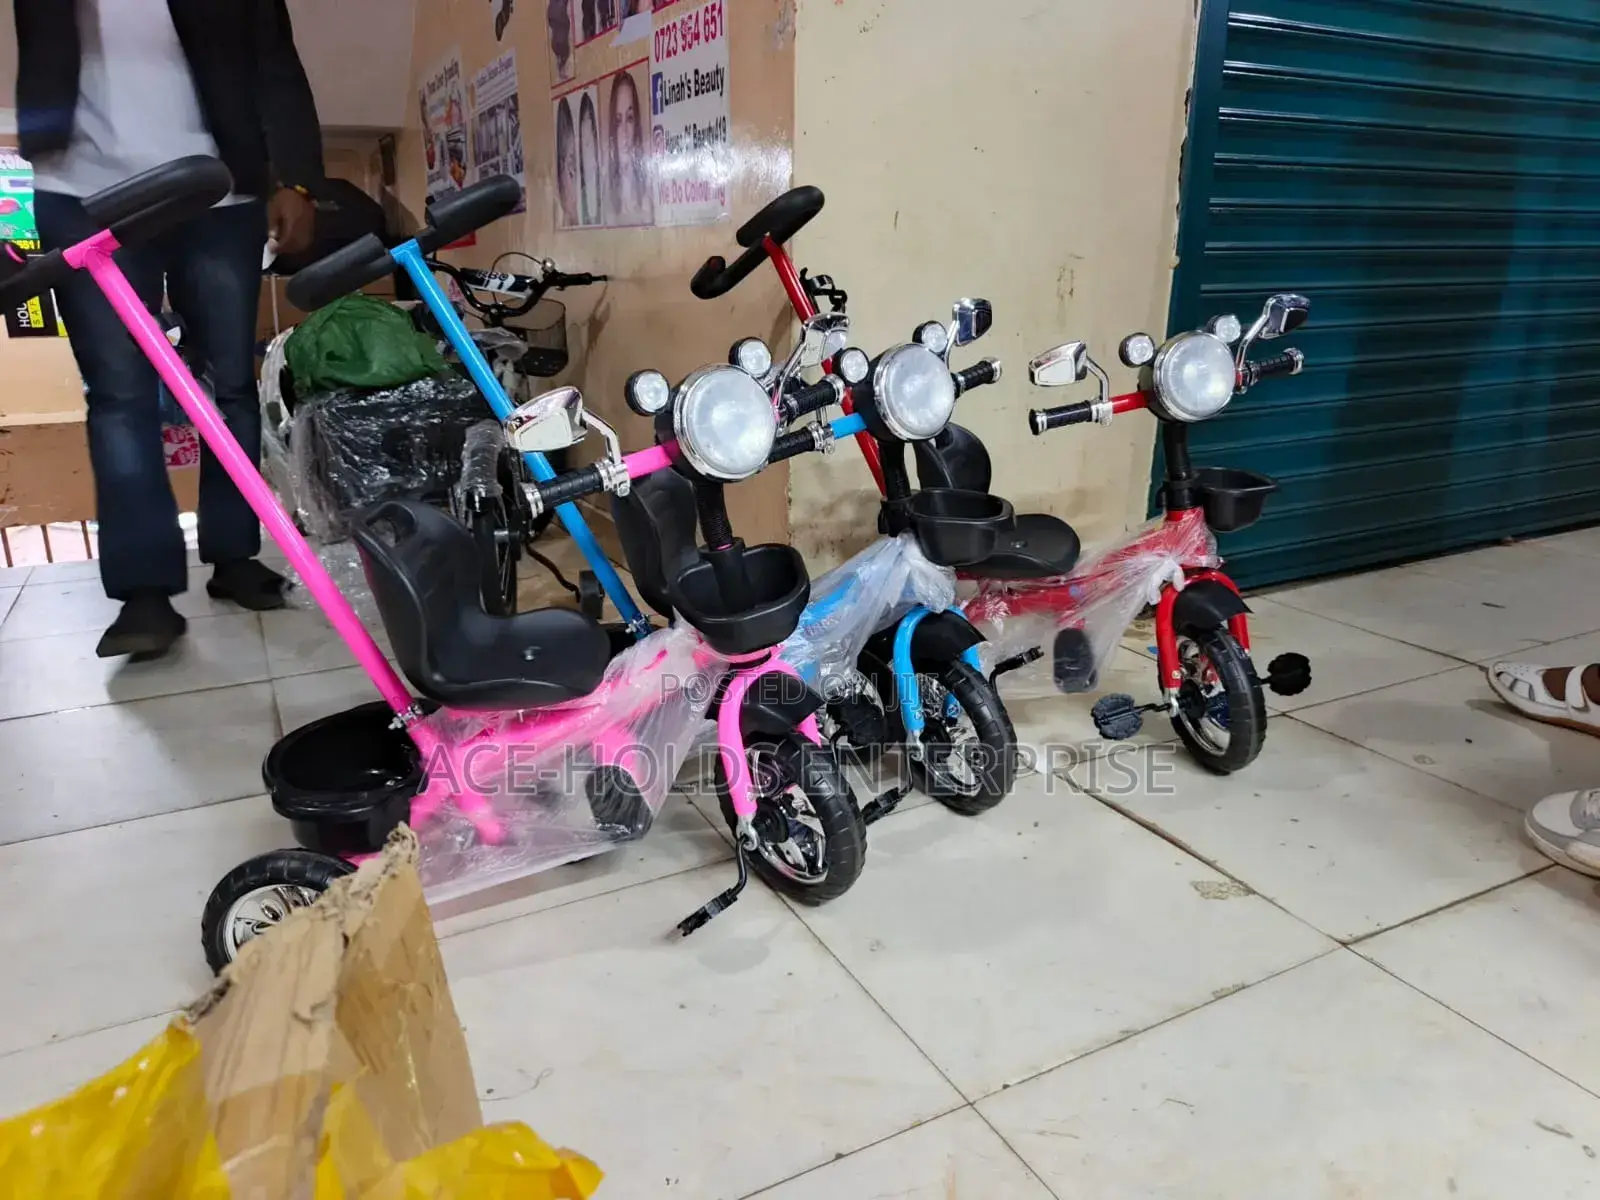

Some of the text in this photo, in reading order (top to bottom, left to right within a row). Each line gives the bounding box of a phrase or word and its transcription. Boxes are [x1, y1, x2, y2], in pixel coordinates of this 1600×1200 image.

[654, 21, 678, 63] 0723
[703, 0, 723, 43] 651
[664, 61, 725, 106] Linah's Beauty
